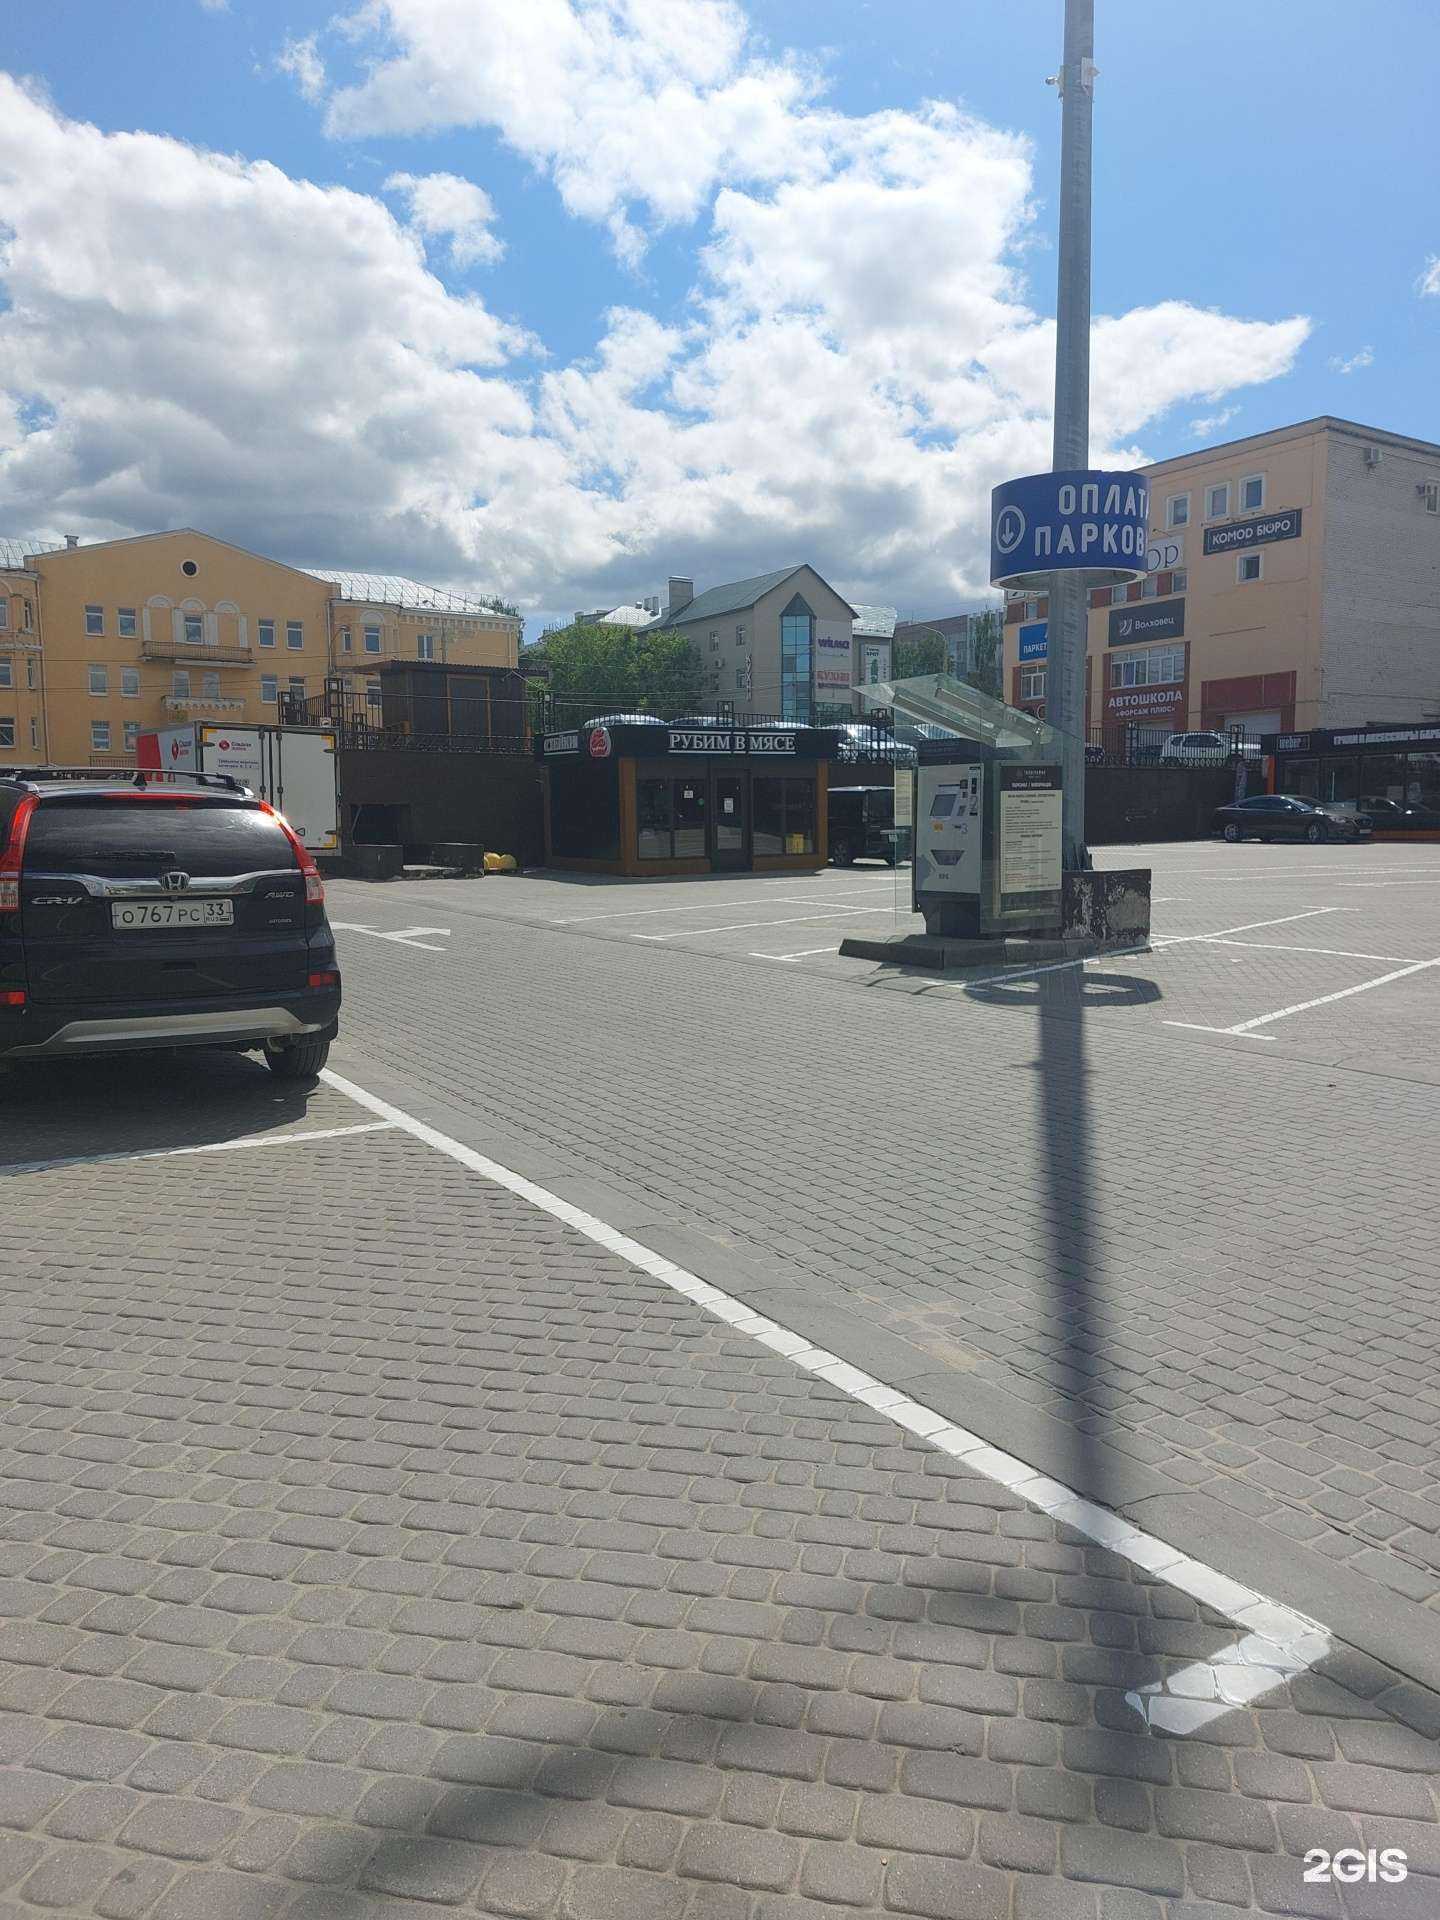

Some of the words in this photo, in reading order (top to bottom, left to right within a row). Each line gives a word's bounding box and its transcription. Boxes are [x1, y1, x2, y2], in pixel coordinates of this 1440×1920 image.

[1256, 519, 1291, 537] БЮРО
[1034, 522, 1149, 557] ПАРКОВ
[1134, 616, 1175, 630] Волховец
[1108, 690, 1183, 708] АВТОШКОЛА
[669, 734, 730, 750] РУБИМ
[734, 736, 746, 750] В
[749, 736, 796, 751] МЯСЕ
[32, 896, 83, 904] CR-V
[264, 891, 296, 899] AWD
[206, 903, 225, 916] 33
